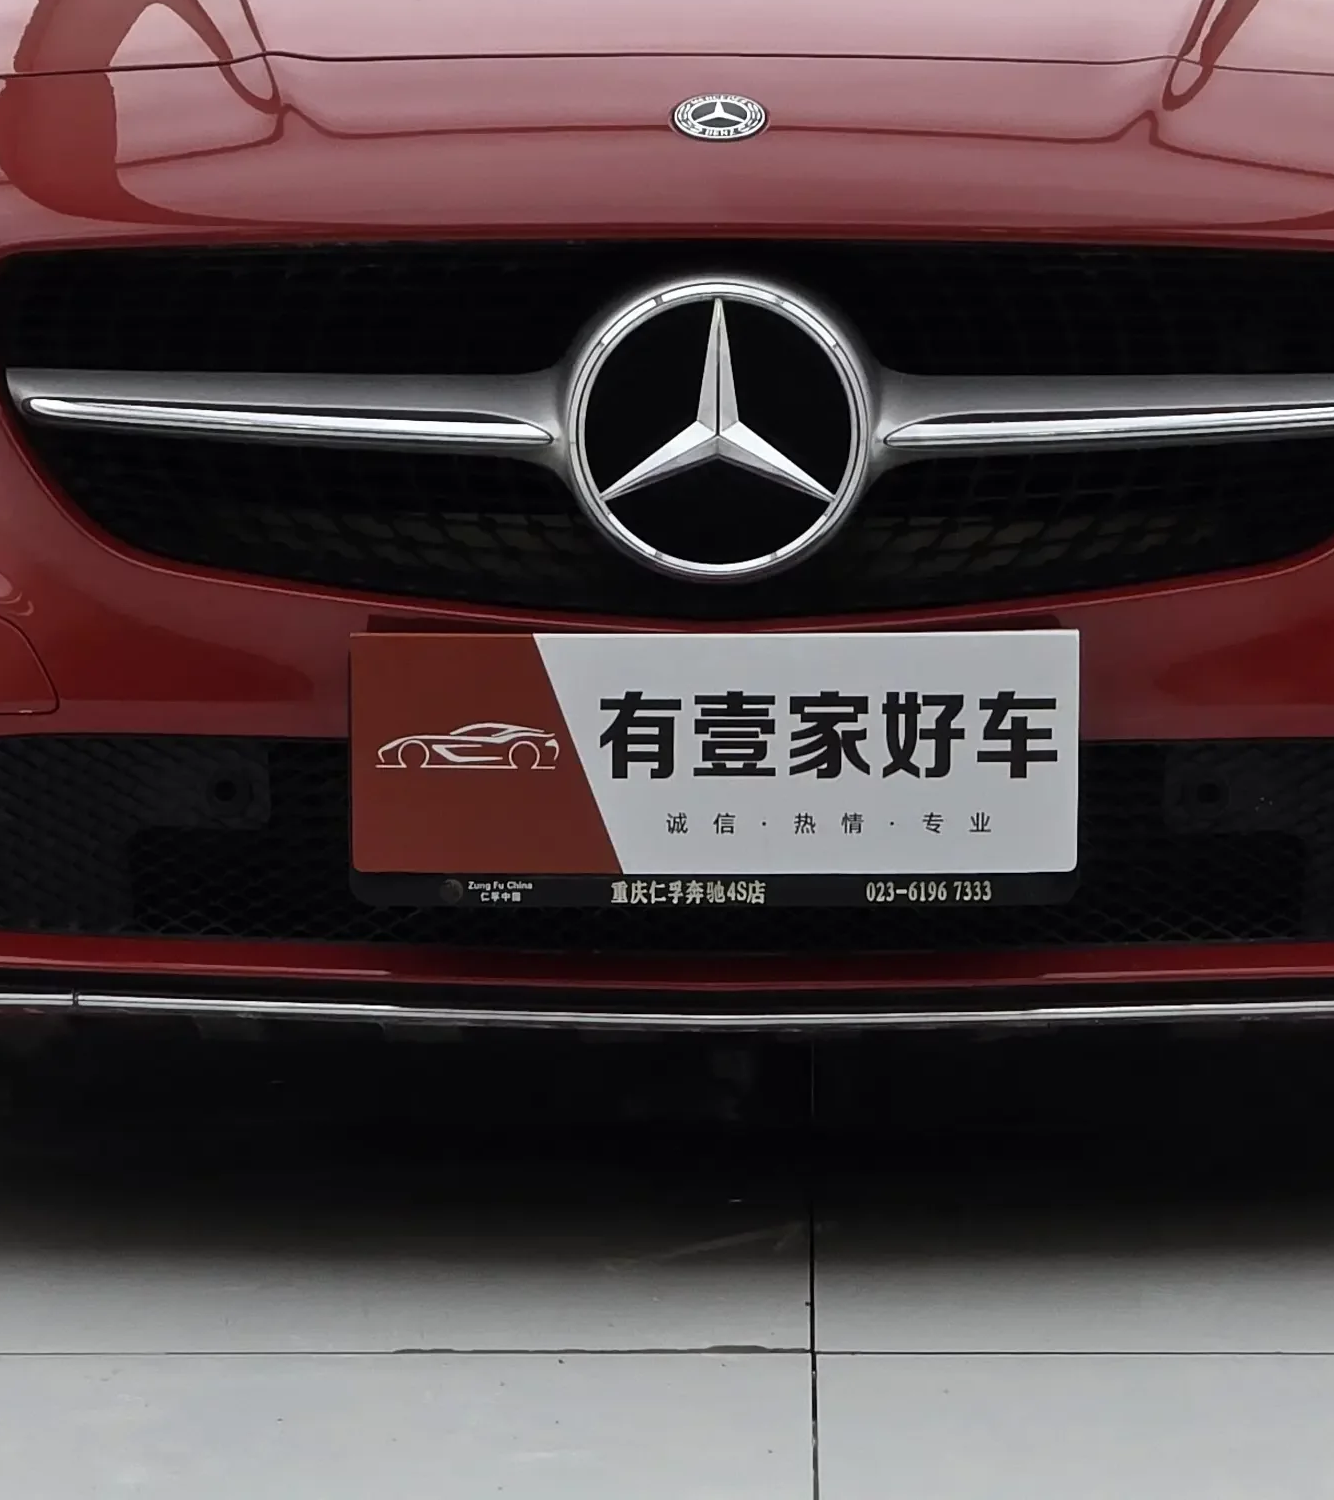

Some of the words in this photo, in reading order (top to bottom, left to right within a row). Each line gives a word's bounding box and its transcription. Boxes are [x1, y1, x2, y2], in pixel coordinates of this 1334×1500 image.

[599, 690, 1059, 780] 有壹家好车
[468, 881, 492, 891] Zung
[493, 881, 505, 890] Fu
[506, 881, 533, 890] China
[611, 880, 767, 905] 重庆仁孚奔驰4S店
[866, 882, 947, 902] 023-6196
[953, 881, 993, 902] 7333
